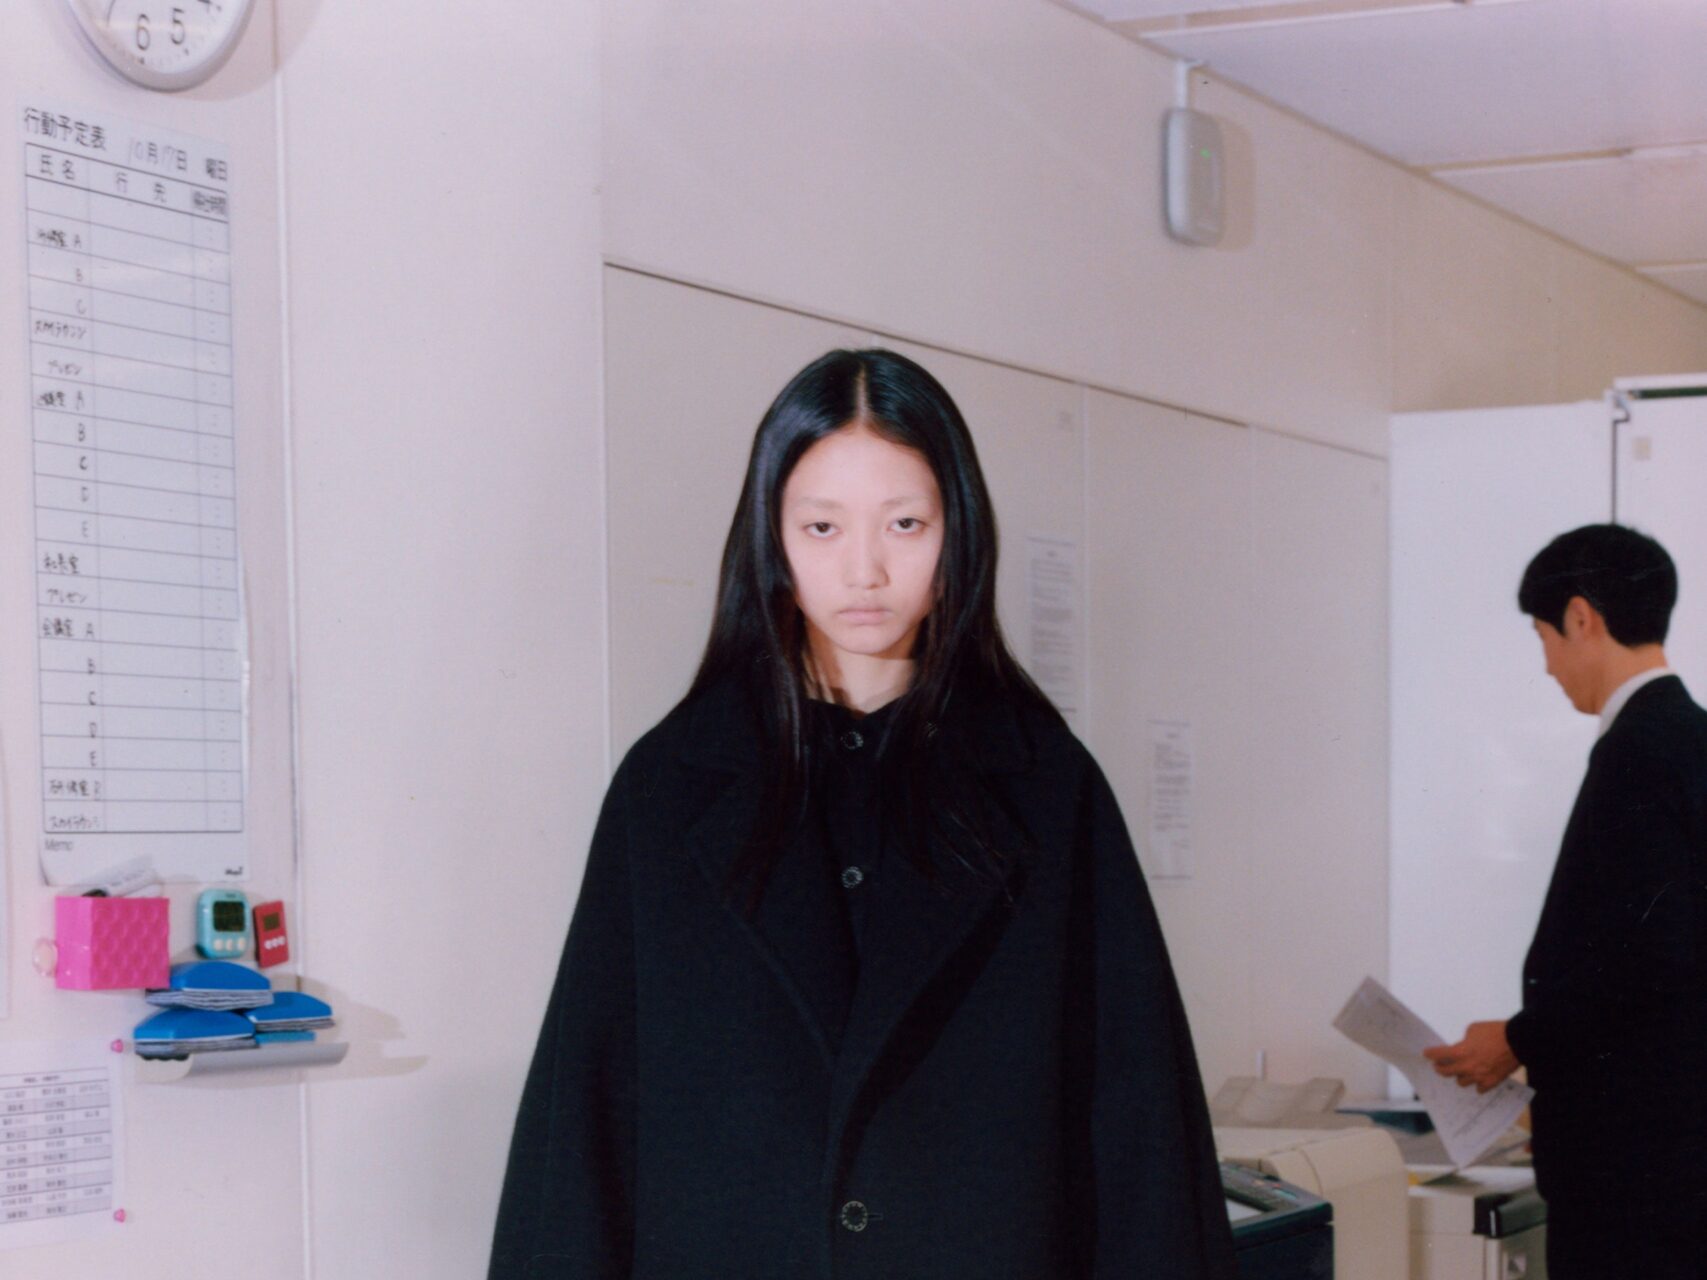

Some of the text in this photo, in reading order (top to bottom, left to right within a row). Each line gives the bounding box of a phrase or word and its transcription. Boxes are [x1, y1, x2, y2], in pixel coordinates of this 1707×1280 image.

[136, 13, 150, 51] 6
[171, 7, 185, 46] 5
[24, 107, 106, 151] 行動予定表
[79, 455, 88, 471] C
[88, 690, 97, 706] C
